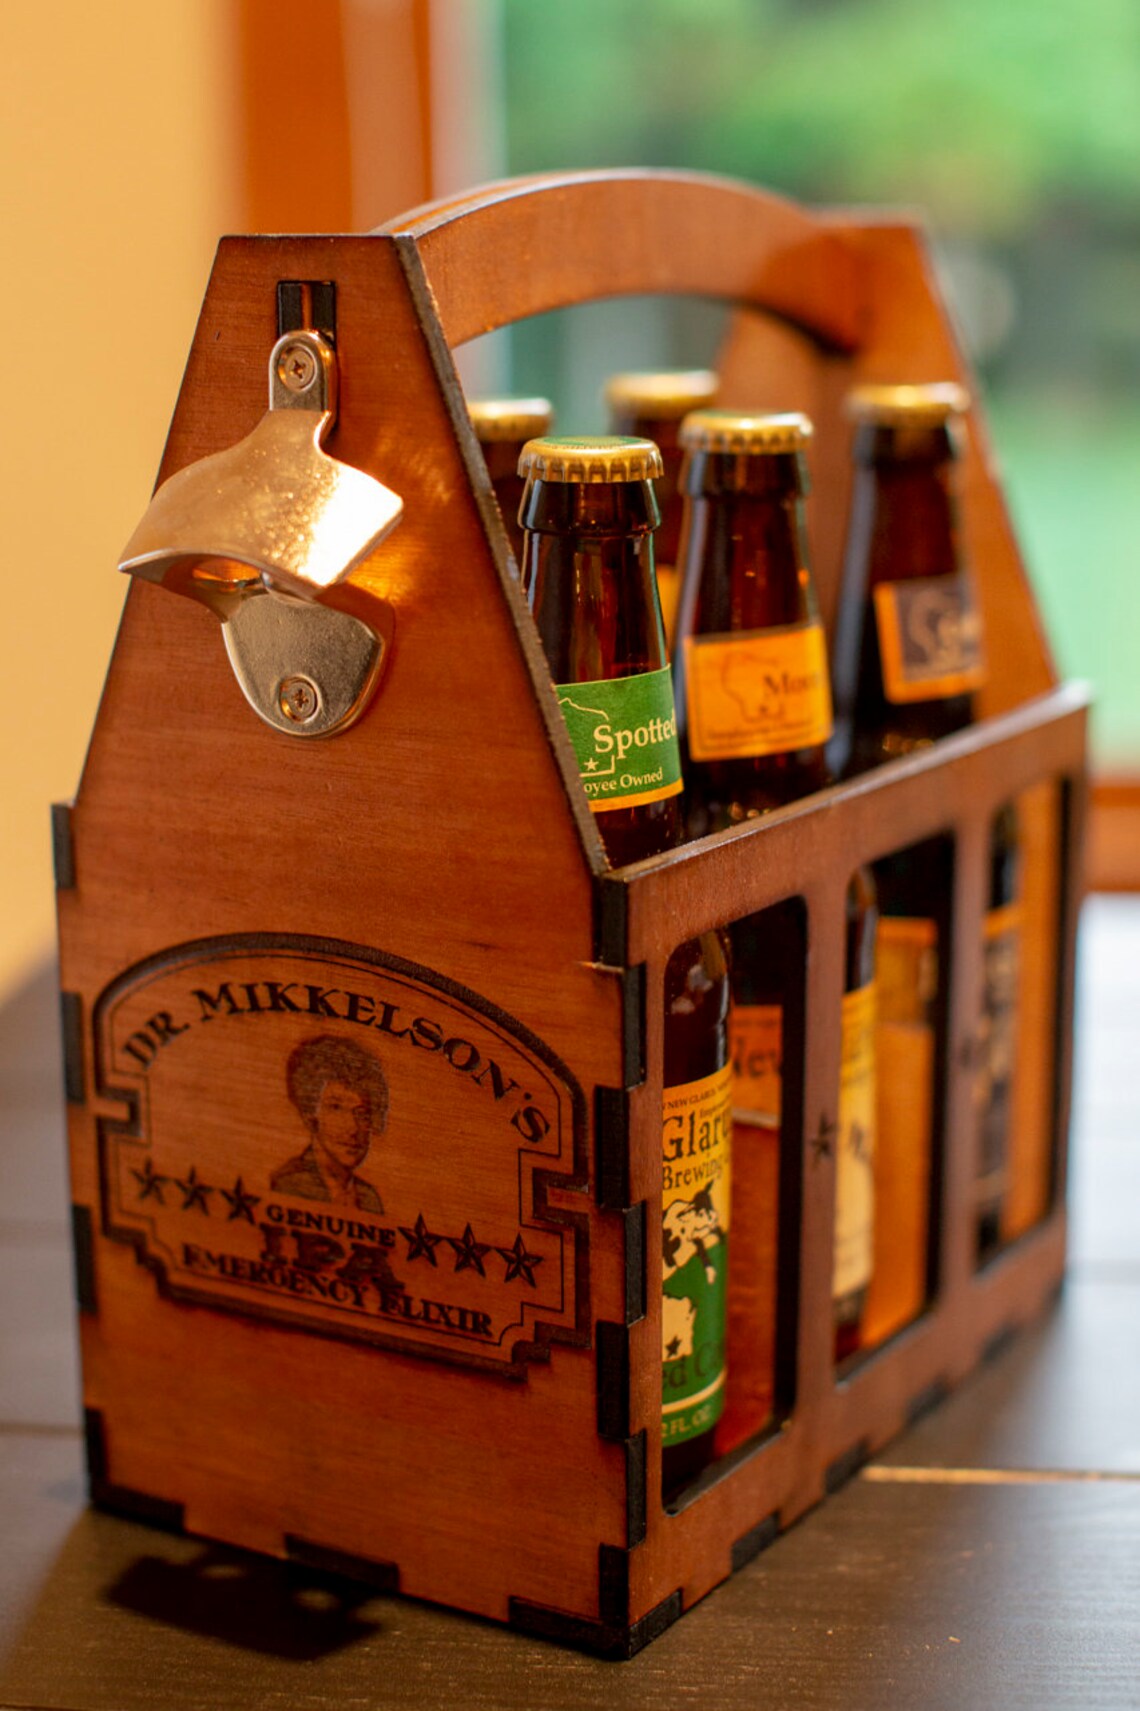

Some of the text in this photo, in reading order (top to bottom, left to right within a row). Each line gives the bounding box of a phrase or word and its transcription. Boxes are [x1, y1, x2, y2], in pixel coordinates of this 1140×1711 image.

[620, 767, 663, 788] Owned
[191, 981, 551, 1144] MIKKELSON'S
[265, 1203, 396, 1248] GENUINE
[181, 1242, 494, 1338] EMERGENCY ELIXIR
